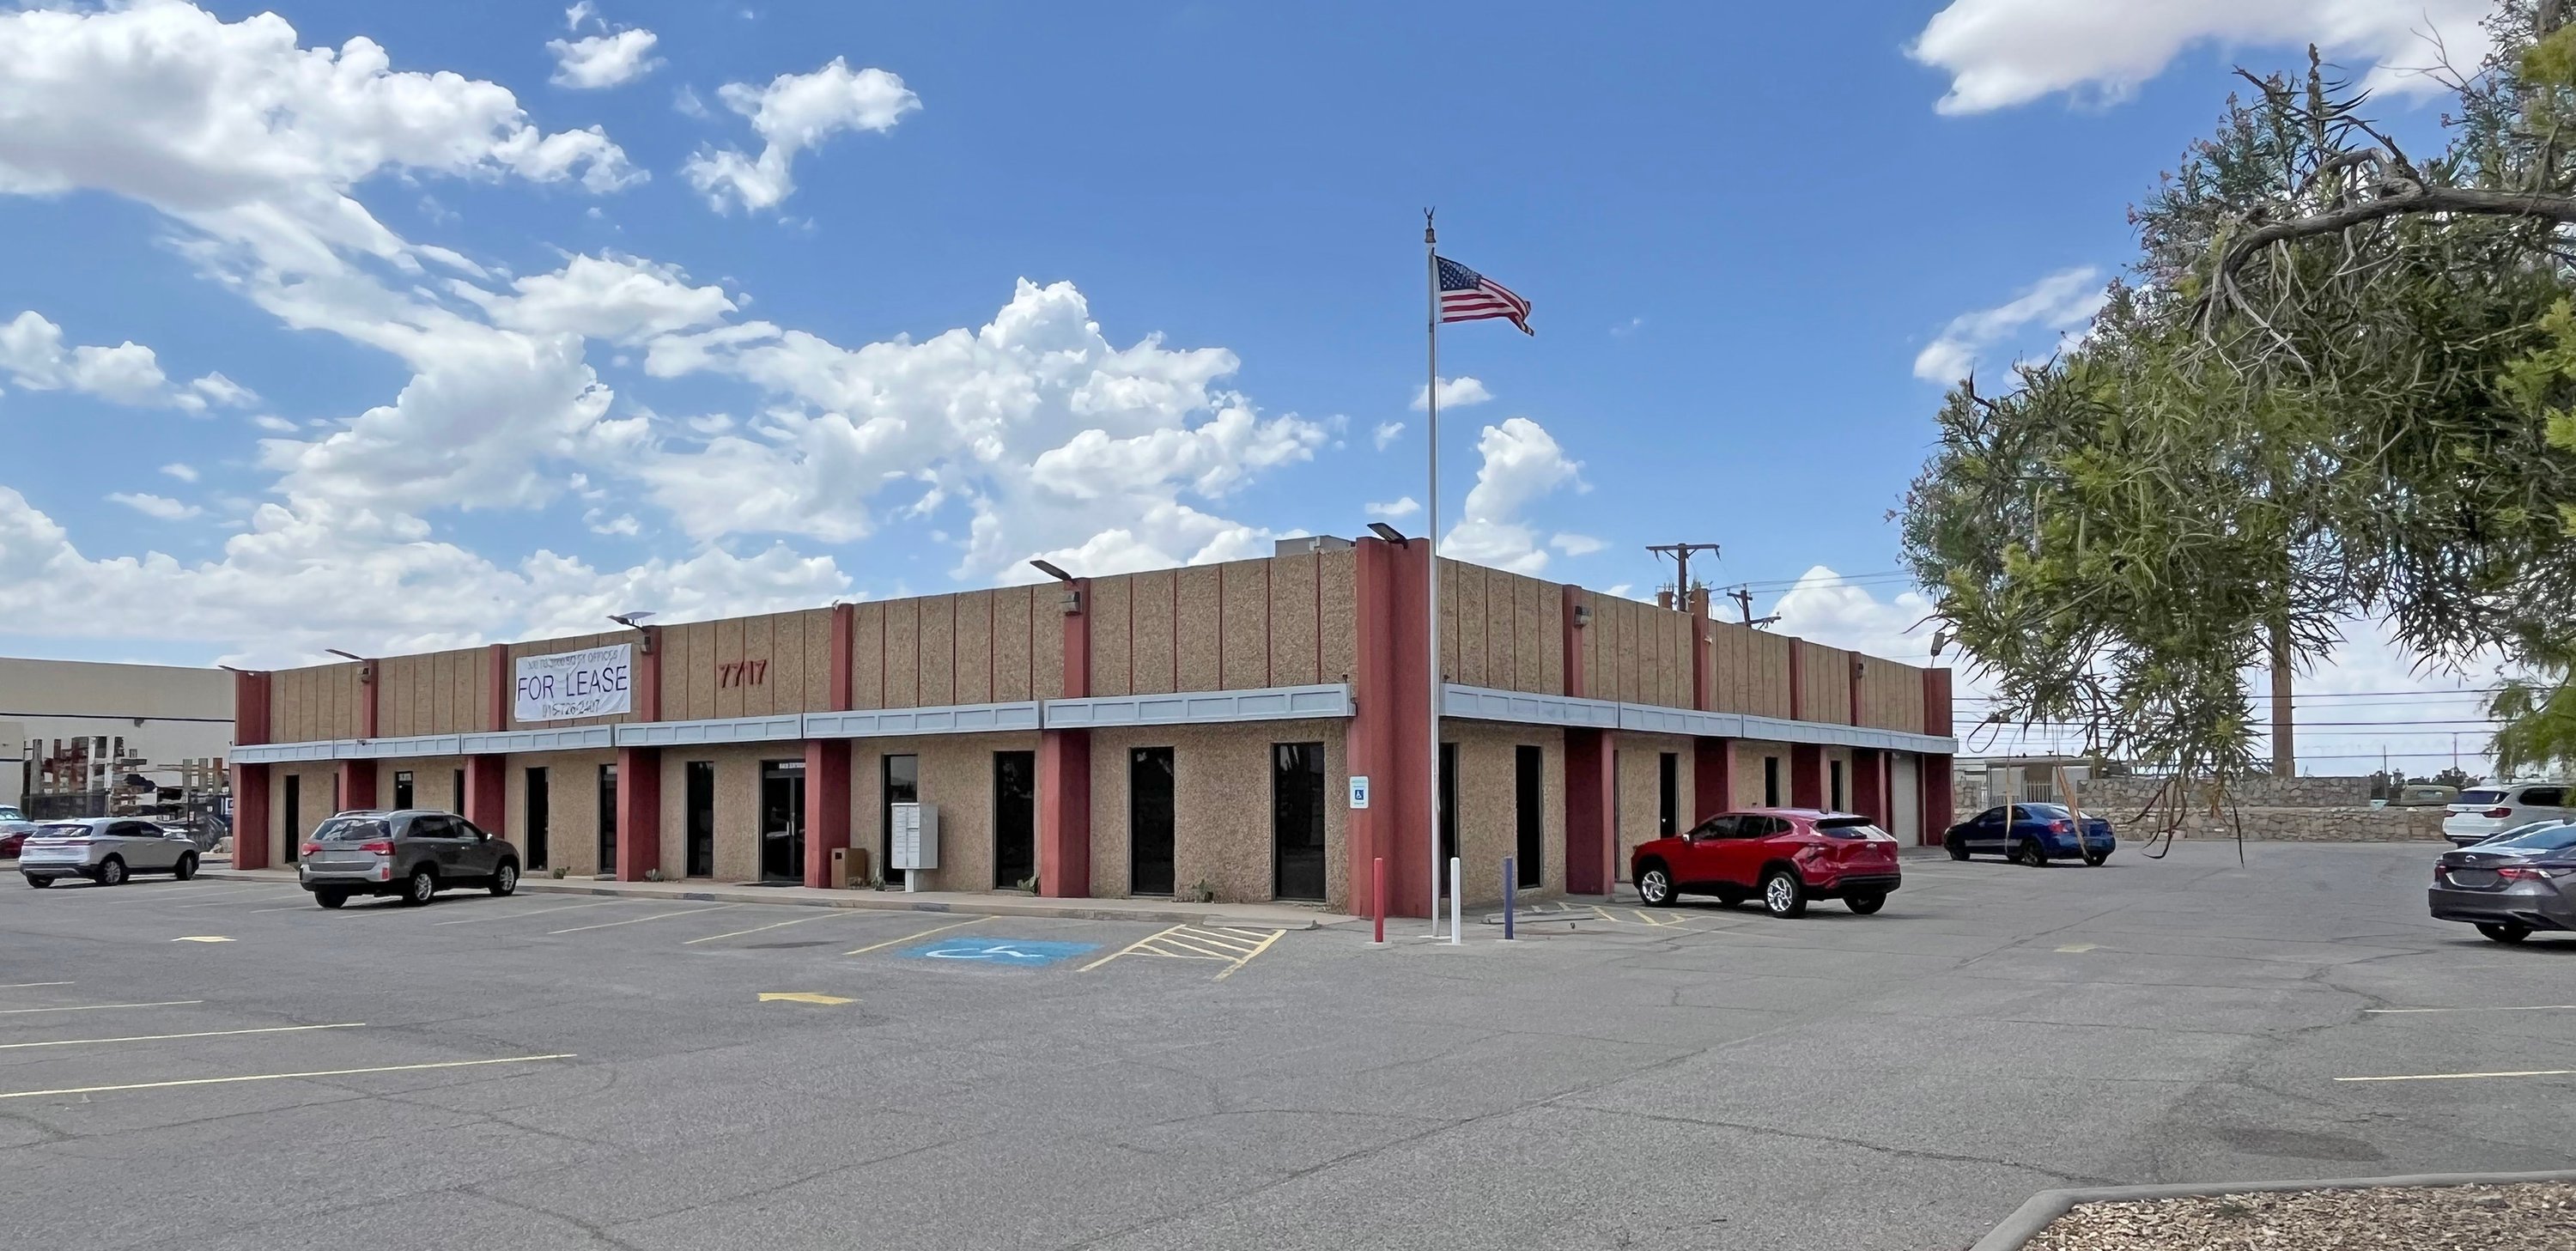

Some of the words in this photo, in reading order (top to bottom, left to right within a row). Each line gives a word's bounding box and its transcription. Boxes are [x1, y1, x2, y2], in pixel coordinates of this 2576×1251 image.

[518, 675, 554, 701] FOR
[566, 665, 628, 697] LEASE
[718, 659, 767, 688] 7717
